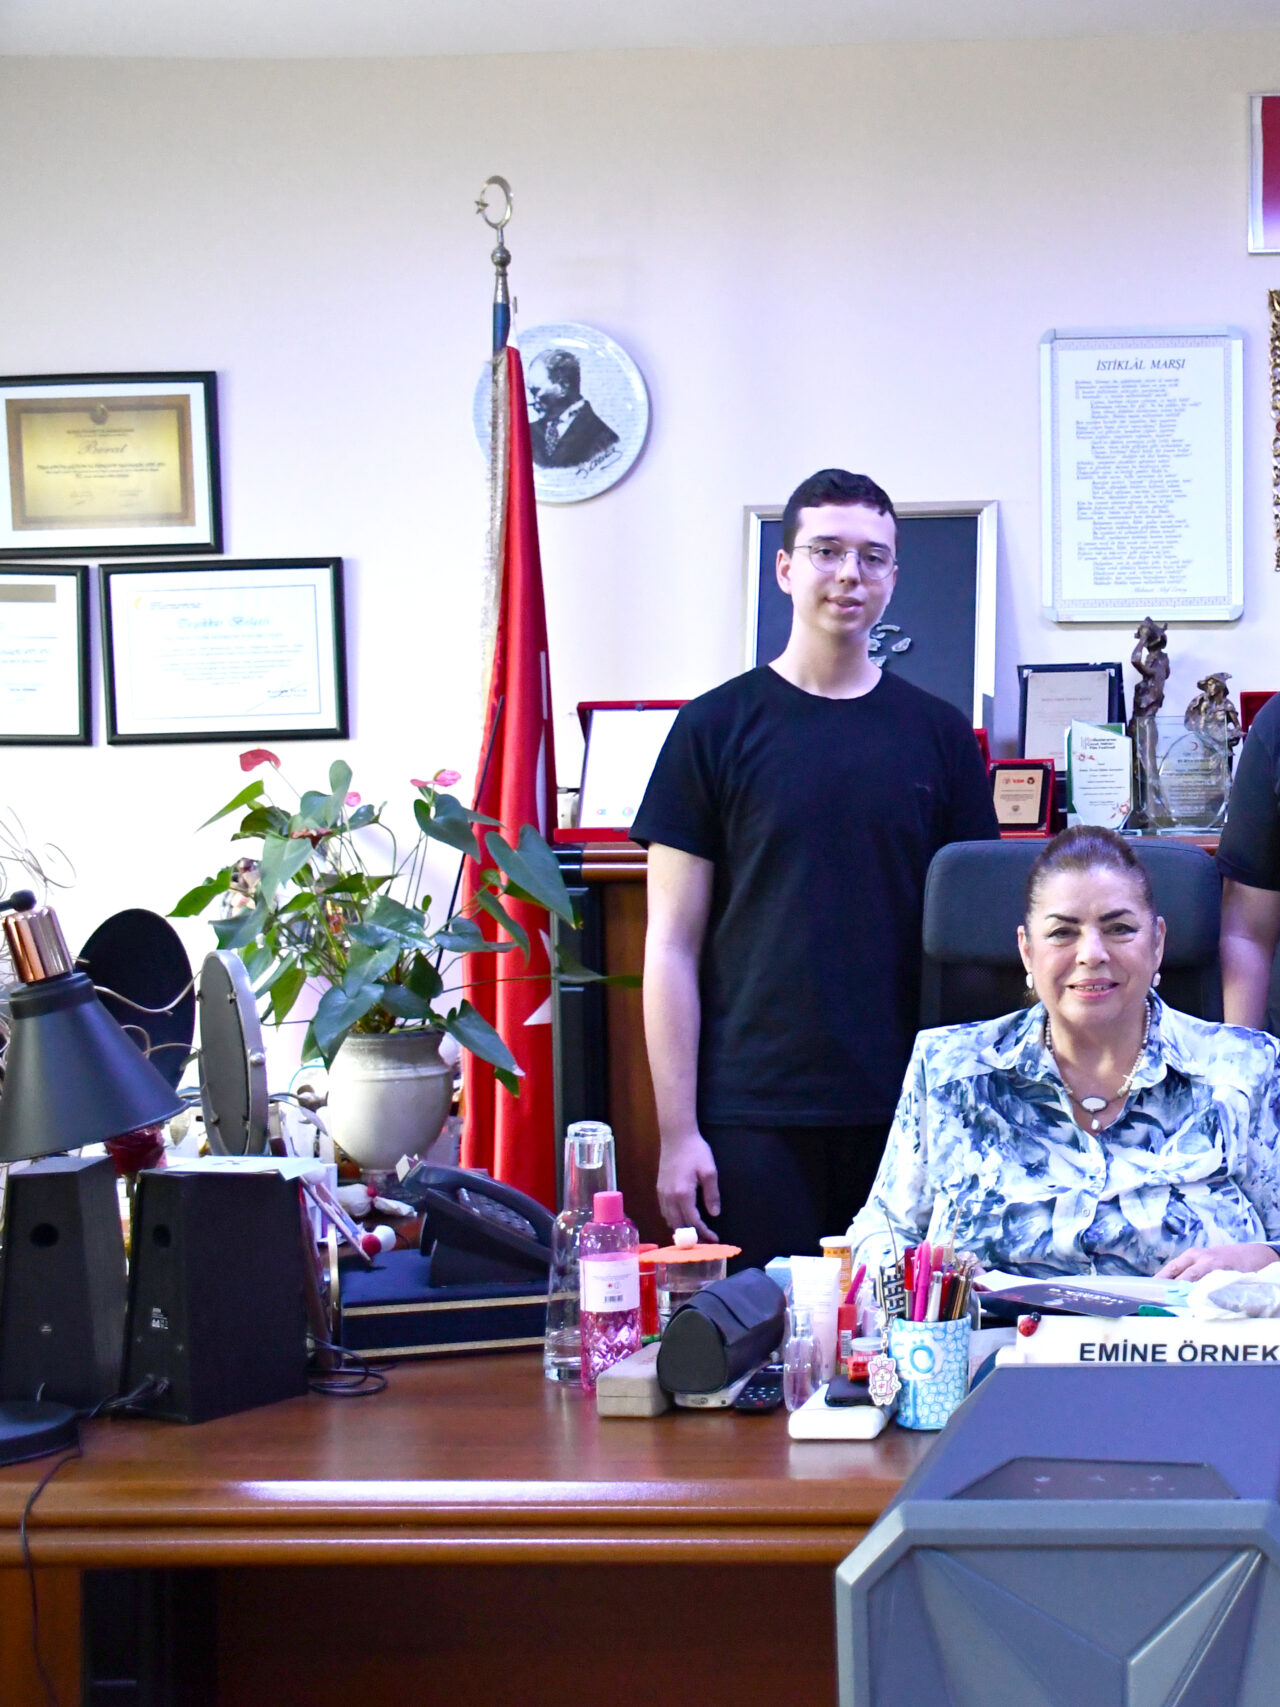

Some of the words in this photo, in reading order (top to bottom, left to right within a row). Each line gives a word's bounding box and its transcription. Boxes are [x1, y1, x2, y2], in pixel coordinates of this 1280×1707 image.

[1096, 356, 1146, 371] İSTİKLÂL
[1150, 357, 1186, 371] MARŞI
[1079, 1338, 1168, 1363] EMİNE
[1177, 1339, 1280, 1363] ÖRNEK
